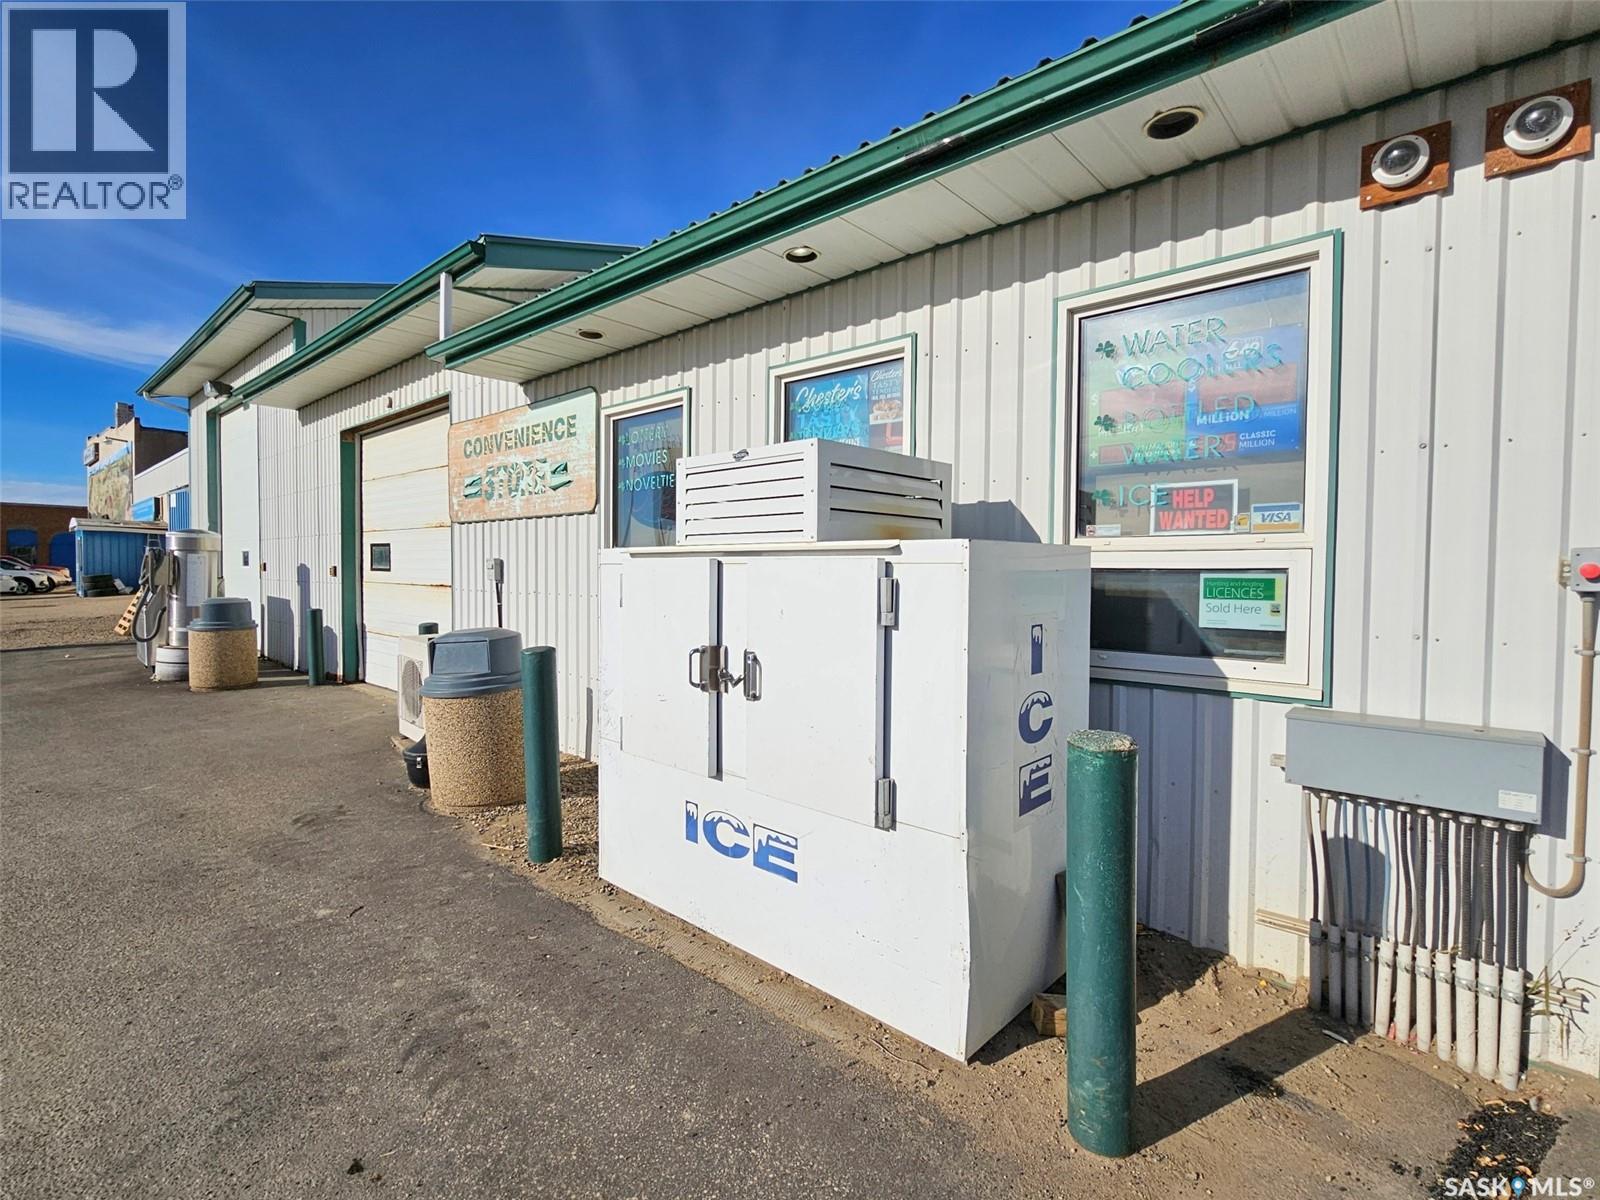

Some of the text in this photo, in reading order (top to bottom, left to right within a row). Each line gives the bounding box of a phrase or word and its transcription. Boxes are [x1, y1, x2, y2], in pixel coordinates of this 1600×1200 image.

[1121, 317, 1226, 358] WATER
[795, 380, 862, 413] Chester's
[463, 414, 577, 459] CONVENIENCE
[1239, 429, 1276, 441] CLASSIC
[1239, 438, 1276, 449] MILLION
[625, 449, 669, 469] MOVIES
[1118, 480, 1170, 508] ICE
[1172, 488, 1216, 509] HELP
[1158, 509, 1230, 531] WANTED
[1260, 511, 1293, 524] VISA
[1206, 587, 1264, 600] LICENCES
[1206, 602, 1263, 615] Sold Here
[1018, 623, 1054, 817] ICE
[685, 800, 799, 884] ICE
